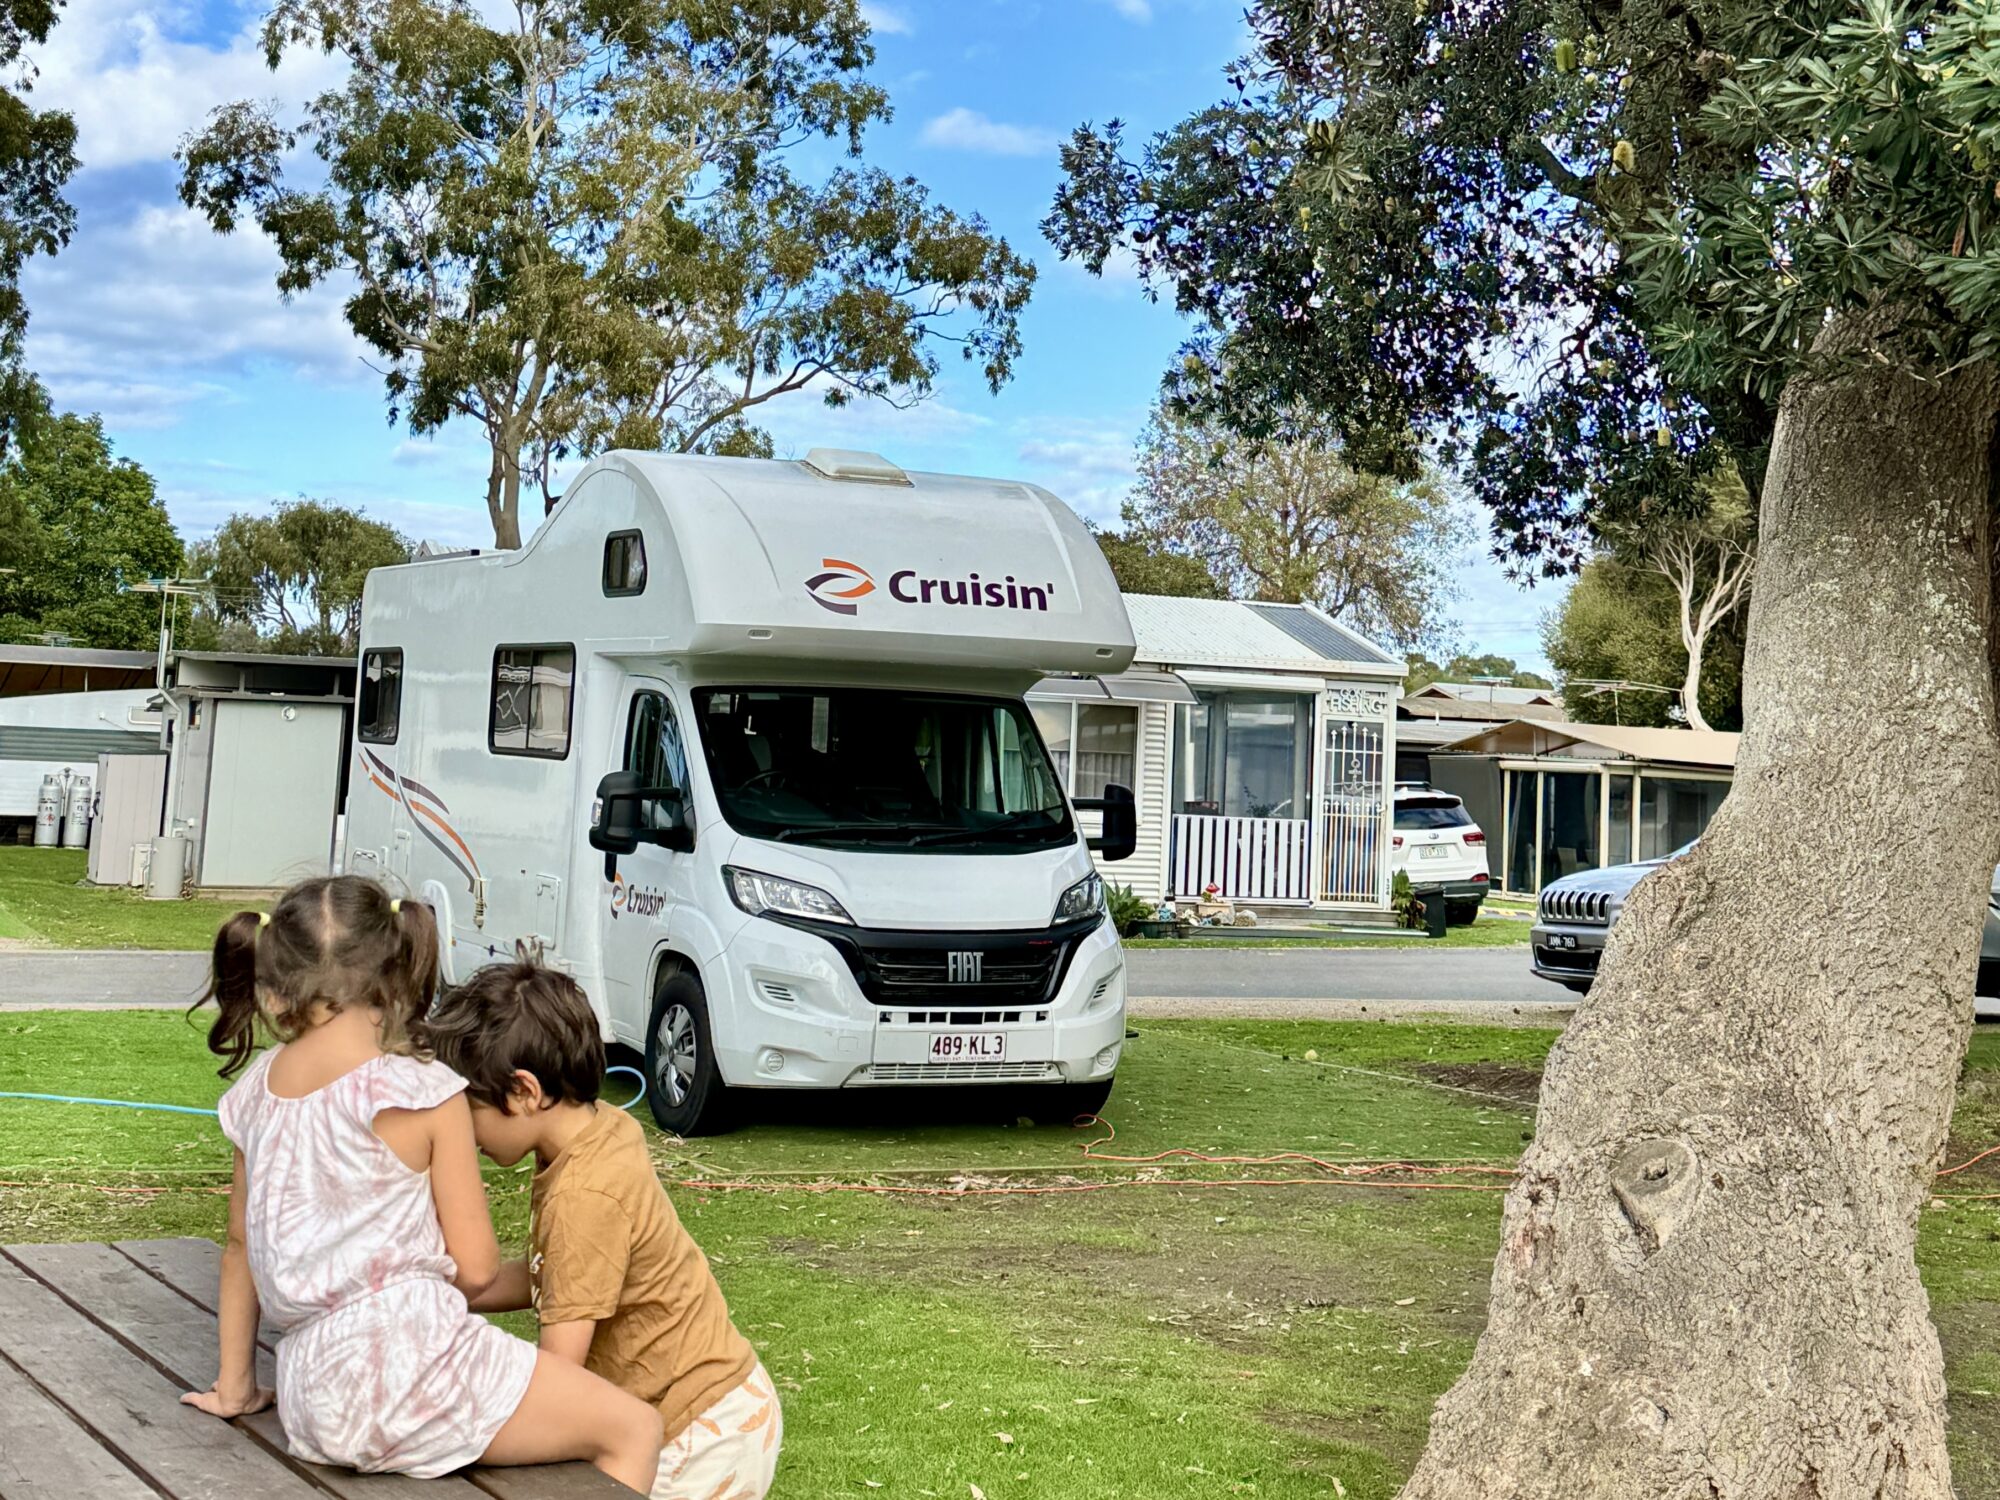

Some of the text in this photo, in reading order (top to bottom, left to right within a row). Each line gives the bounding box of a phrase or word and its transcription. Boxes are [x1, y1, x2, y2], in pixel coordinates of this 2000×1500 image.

[889, 570, 1054, 611] Cruisin'
[1330, 697, 1382, 714] FISHING
[627, 884, 666, 917] Cruisin'
[948, 951, 984, 982] FIAT
